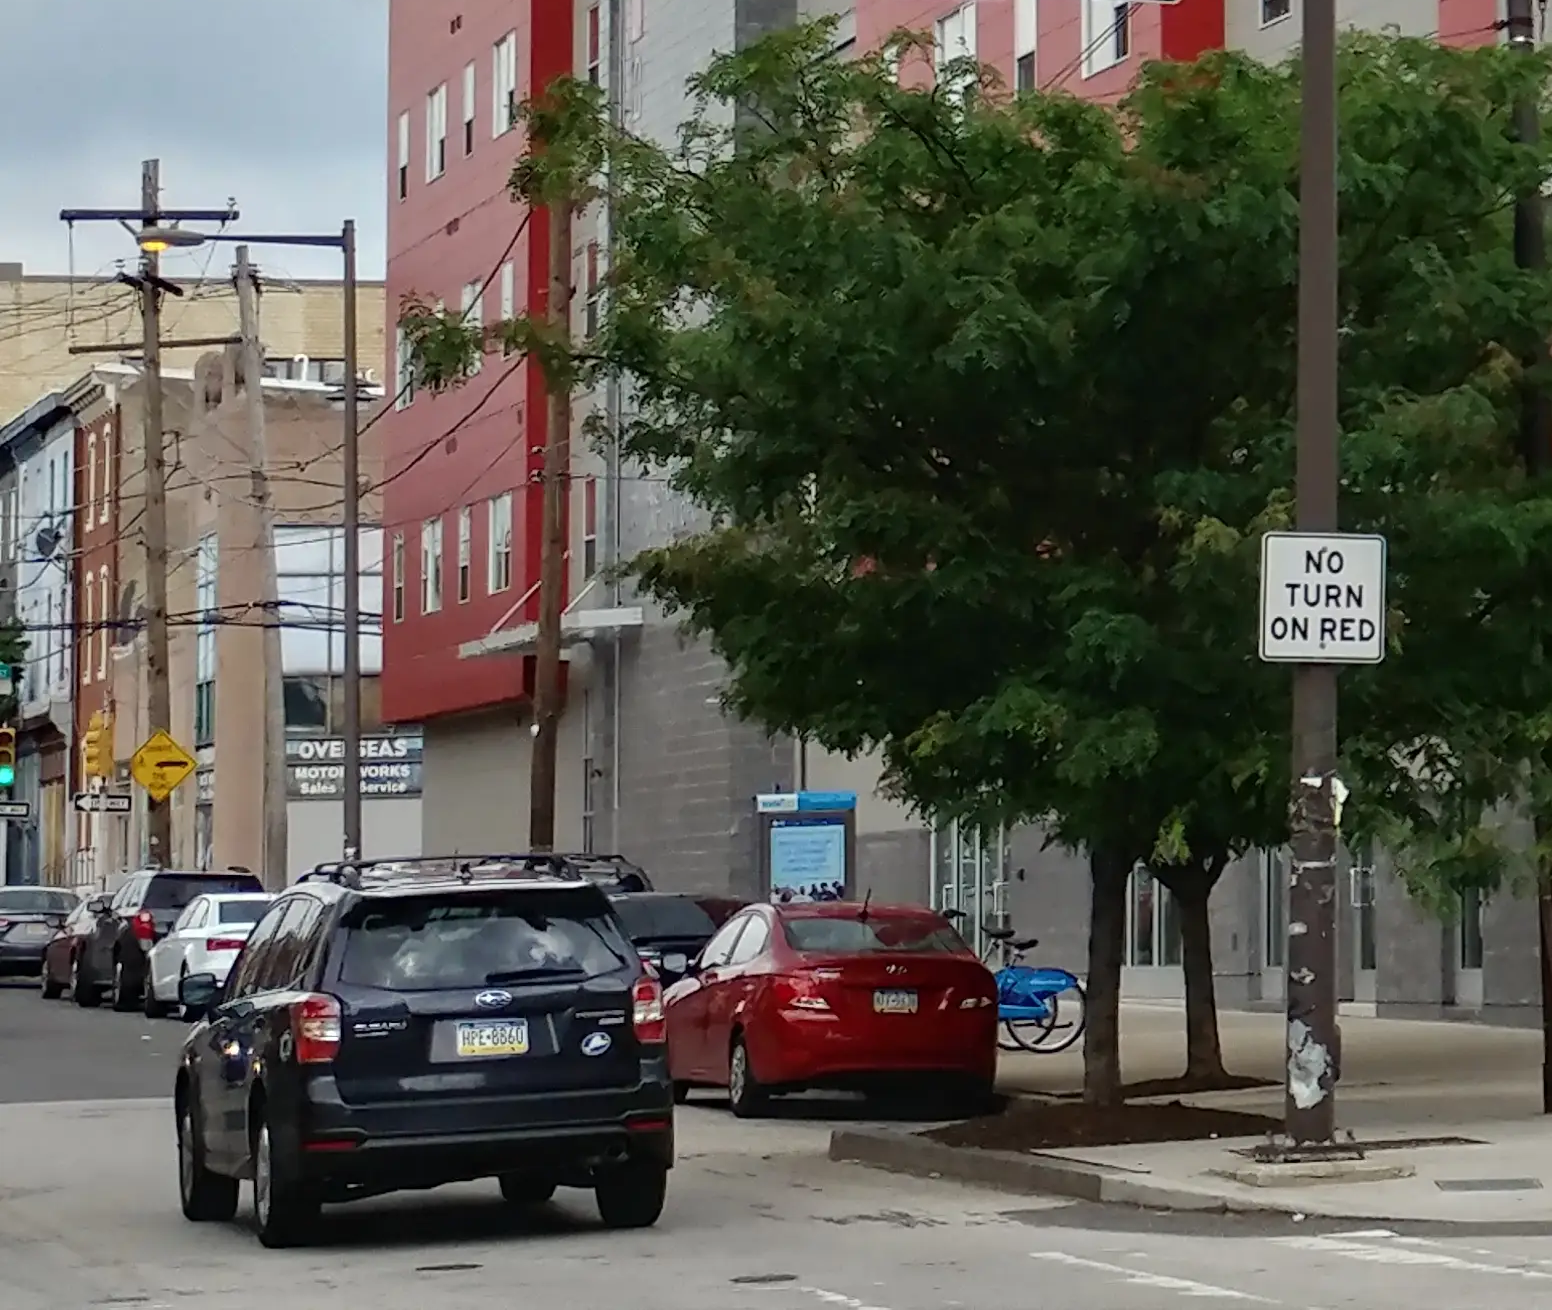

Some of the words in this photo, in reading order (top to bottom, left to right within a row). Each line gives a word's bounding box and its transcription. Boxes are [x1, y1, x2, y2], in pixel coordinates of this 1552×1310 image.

[1304, 550, 1344, 574] NO
[1285, 583, 1363, 608] TURN
[1270, 616, 1309, 641] ON
[1319, 616, 1376, 643] RED
[298, 738, 408, 760] OVESEAS
[299, 781, 337, 795] Sales
